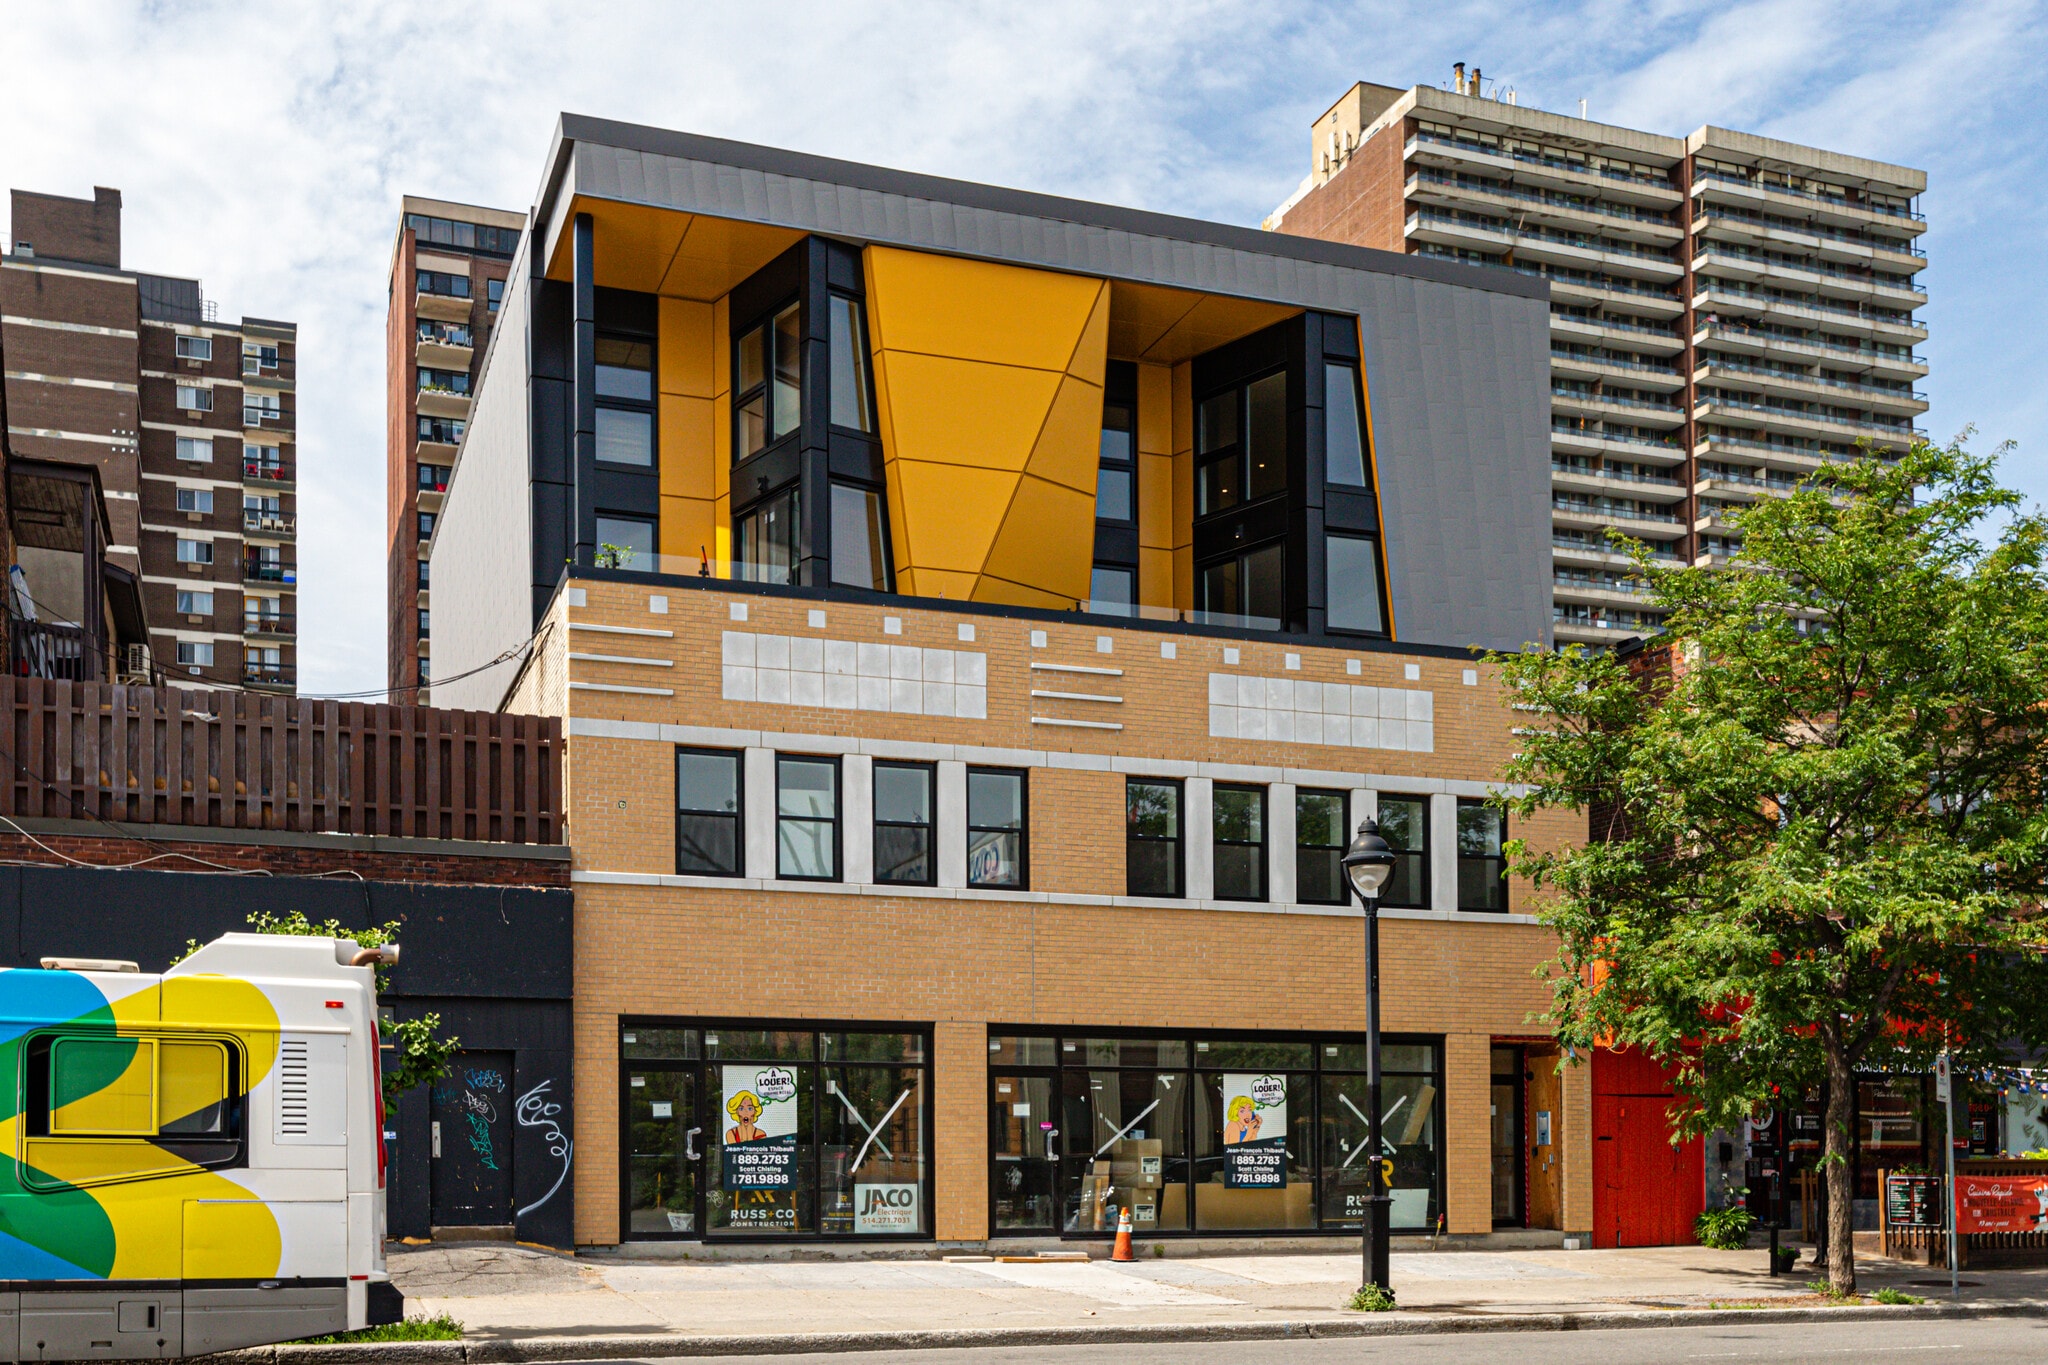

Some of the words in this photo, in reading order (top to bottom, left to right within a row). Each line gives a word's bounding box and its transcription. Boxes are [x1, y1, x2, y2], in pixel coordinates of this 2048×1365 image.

[760, 1077, 790, 1086] LOUER!
[1254, 1084, 1280, 1093] LOUER!
[737, 1154, 789, 1165] 889.2783
[1236, 1155, 1280, 1165] 889.2783
[738, 1174, 789, 1184] 781.9898
[1236, 1174, 1280, 1183] 781.9898
[860, 1188, 913, 1216] JACO
[730, 1209, 795, 1219] RUSS+CO
